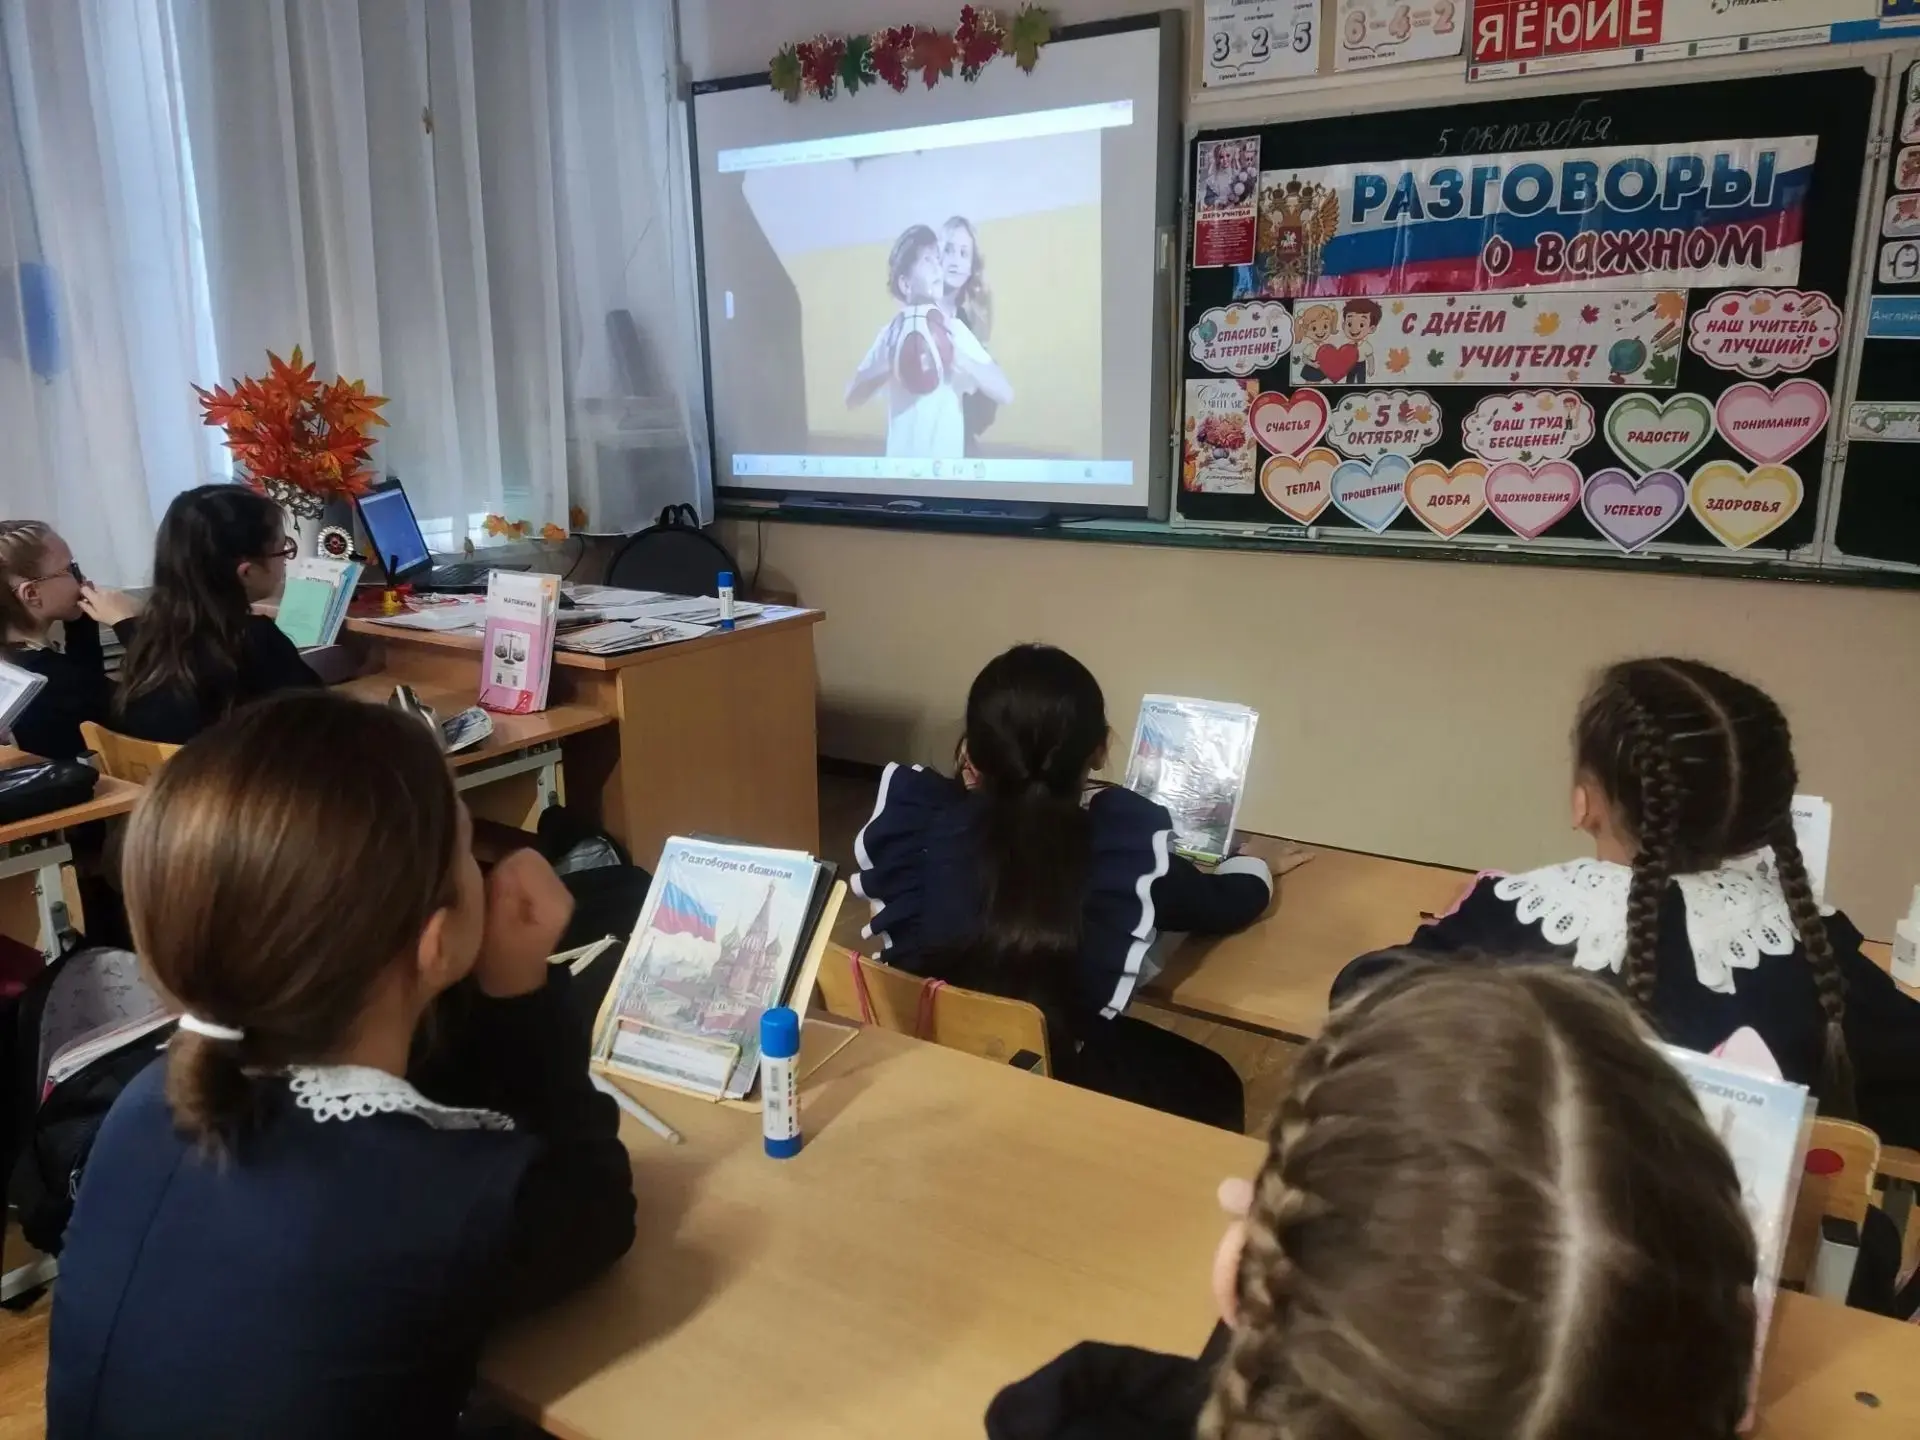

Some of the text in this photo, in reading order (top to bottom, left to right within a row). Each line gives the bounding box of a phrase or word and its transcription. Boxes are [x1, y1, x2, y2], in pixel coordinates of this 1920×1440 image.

[1344, 11, 1367, 44] 6
[1433, 0, 1456, 35] 2
[1212, 31, 1231, 62] 3
[1251, 26, 1270, 57] 2
[1292, 21, 1312, 52] 5
[1432, 128, 1454, 156] 5
[1351, 151, 1777, 223] РАЗГОВОРЫ
[1222, 209, 1251, 219] УЧИТЕЛЯ
[1484, 225, 1767, 276] о важном
[1402, 305, 1507, 336] С ДНЁМ
[1706, 320, 1744, 333] НАШ
[1749, 319, 1817, 334] УЧИТЕЛЬ
[1217, 326, 1267, 341] СПАСИБО
[1204, 340, 1282, 359] ЗА ТЕРПЕНИЕ!
[1718, 335, 1813, 355] ЛУЧШИЙ!
[1459, 344, 1598, 368] УЧИТЕЛЯ!
[1374, 404, 1391, 427] 5
[1493, 416, 1563, 432] ВАШ ТРУД
[1733, 416, 1811, 430] ПОНИМАНИЯ
[1266, 419, 1310, 433] СЧАСТЬЯ
[1349, 428, 1418, 445] ОКТЯБРЯ!
[1489, 432, 1566, 449] БЕСЦЕНЕН!
[1627, 431, 1690, 443] РАДОСТИ
[1285, 480, 1321, 496] ТЕПЛА
[1427, 494, 1471, 508] ДОБРА
[1494, 493, 1571, 504] ВДОХНОВЕНИЯ
[1706, 498, 1781, 513] ЗДОРОВЬЯ
[1604, 504, 1662, 517] УСПЕХОВ
[680, 850, 738, 872] Разговоры
[748, 862, 792, 880] важном
